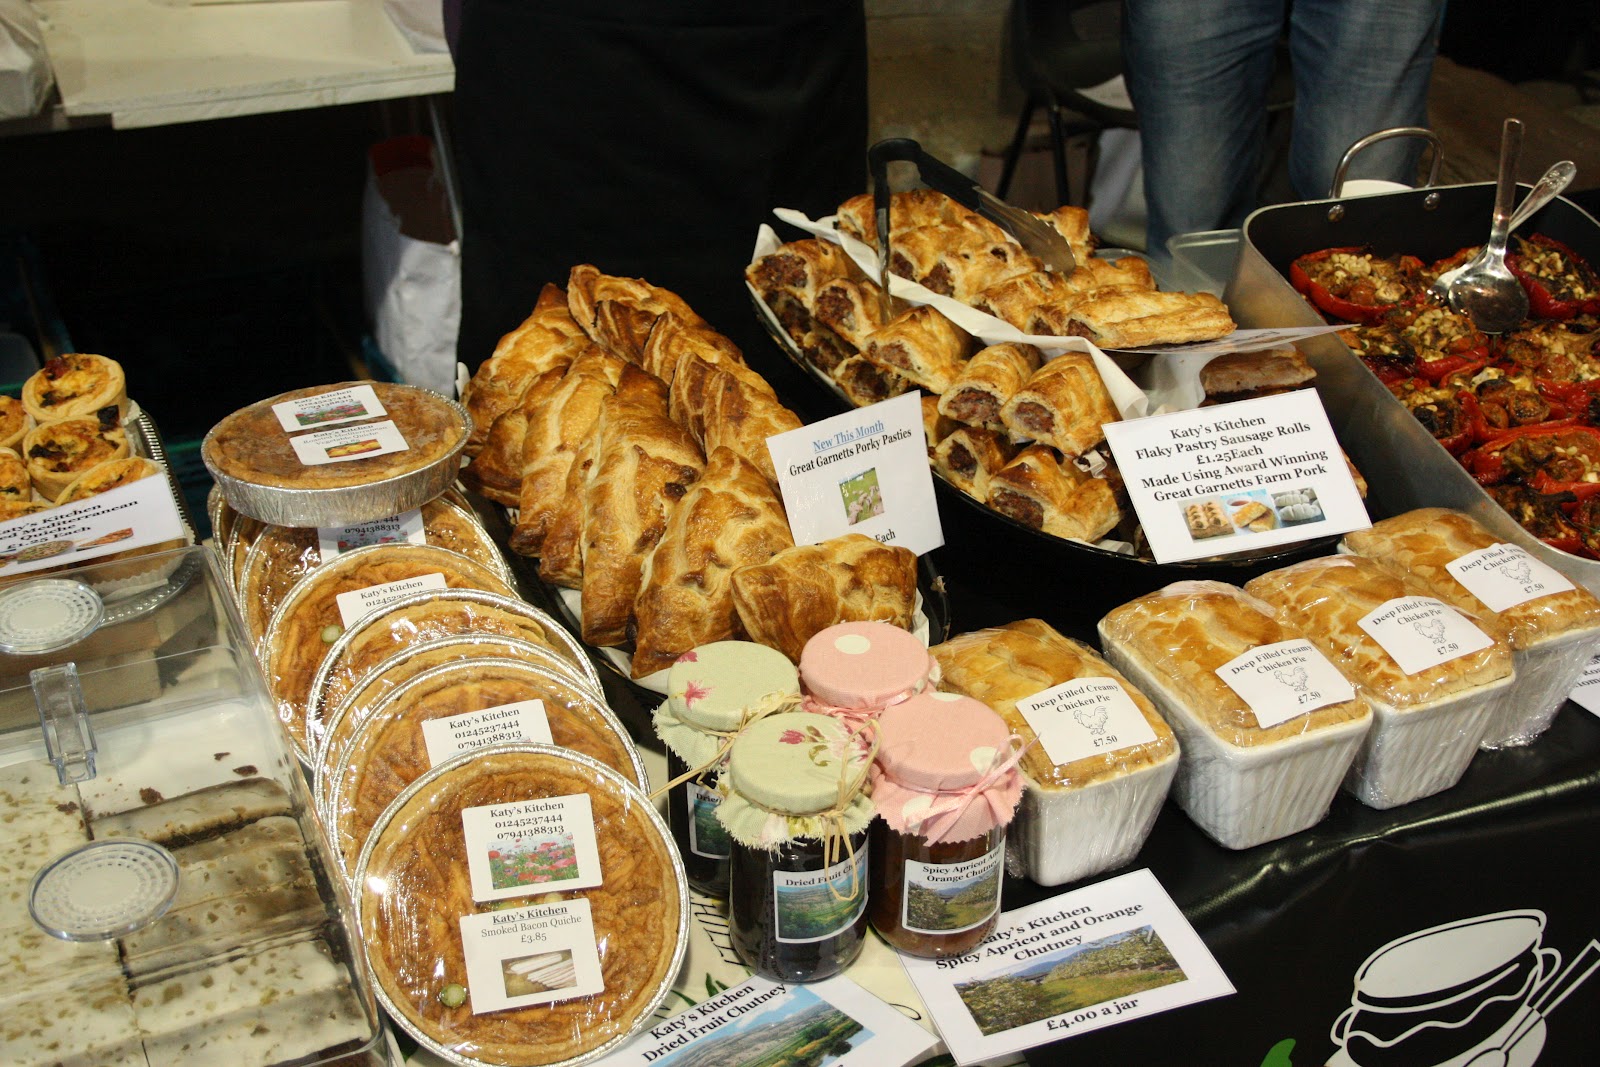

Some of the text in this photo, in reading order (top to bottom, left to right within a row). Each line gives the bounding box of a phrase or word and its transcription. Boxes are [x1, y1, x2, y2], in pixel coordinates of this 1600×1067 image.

[812, 420, 885, 452] New This Month
[1170, 415, 1266, 440] Katy's Kitchen
[790, 428, 912, 476] Great Garnetts Porky Pasties
[1135, 422, 1311, 461] Flaky Pastry Sausage Rolls
[1141, 449, 1329, 489] Made Using Award Winning
[1153, 463, 1327, 502] Great Garnetts Farm Pork
[0, 504, 102, 535] aty's Kitchen
[22, 500, 139, 535] Mediterranean
[20, 523, 76, 542] Quiche
[53, 526, 91, 540] Each
[345, 524, 400, 535] 07941388313
[1460, 559, 1482, 573] Deep
[1481, 548, 1505, 561] Filled
[1483, 555, 1517, 572] Chicken
[360, 580, 423, 600] Katy's Kitchen
[1524, 583, 1545, 595] £7.50
[1372, 610, 1396, 626] Deep
[1395, 601, 1419, 614] Filled
[1397, 612, 1429, 626] Chicken
[1437, 643, 1459, 655] £7.50
[1231, 645, 1313, 675] Deep Filled Creamy
[1256, 655, 1307, 674] Chicken Pie
[1031, 683, 1119, 712] Deep Filled Creamy
[1056, 693, 1111, 713] Chicken Pie
[1298, 690, 1321, 705] £7.50
[449, 708, 520, 730] Katy's Kitchen
[455, 720, 520, 739] 01245237444
[458, 730, 522, 750] 07941388313
[1093, 735, 1118, 747] £7.50
[490, 802, 565, 818] Katy's Kitchen
[495, 814, 563, 829] 01245237444
[497, 825, 565, 840] 07941388313
[923, 865, 950, 874] Spicy
[952, 858, 986, 873] Apricot
[786, 877, 815, 886] Dried
[492, 905, 568, 924] Katy's Kitchen
[1027, 903, 1092, 930] Kitchen
[481, 915, 582, 938] Smoked Bacon Quiche
[690, 895, 751, 967] HILLI
[935, 952, 981, 970] Spicy
[986, 932, 1047, 957] Apricot
[1051, 920, 1081, 936] and
[1083, 902, 1144, 926] Orange
[521, 932, 547, 943] £3.85
[1013, 933, 1084, 962] Chutney
[641, 983, 787, 1062] Dried Fruit Chutney
[649, 1014, 698, 1040] Katy's
[695, 985, 756, 1017] Kitchen
[1046, 997, 1140, 1032] £4.00 a jar
